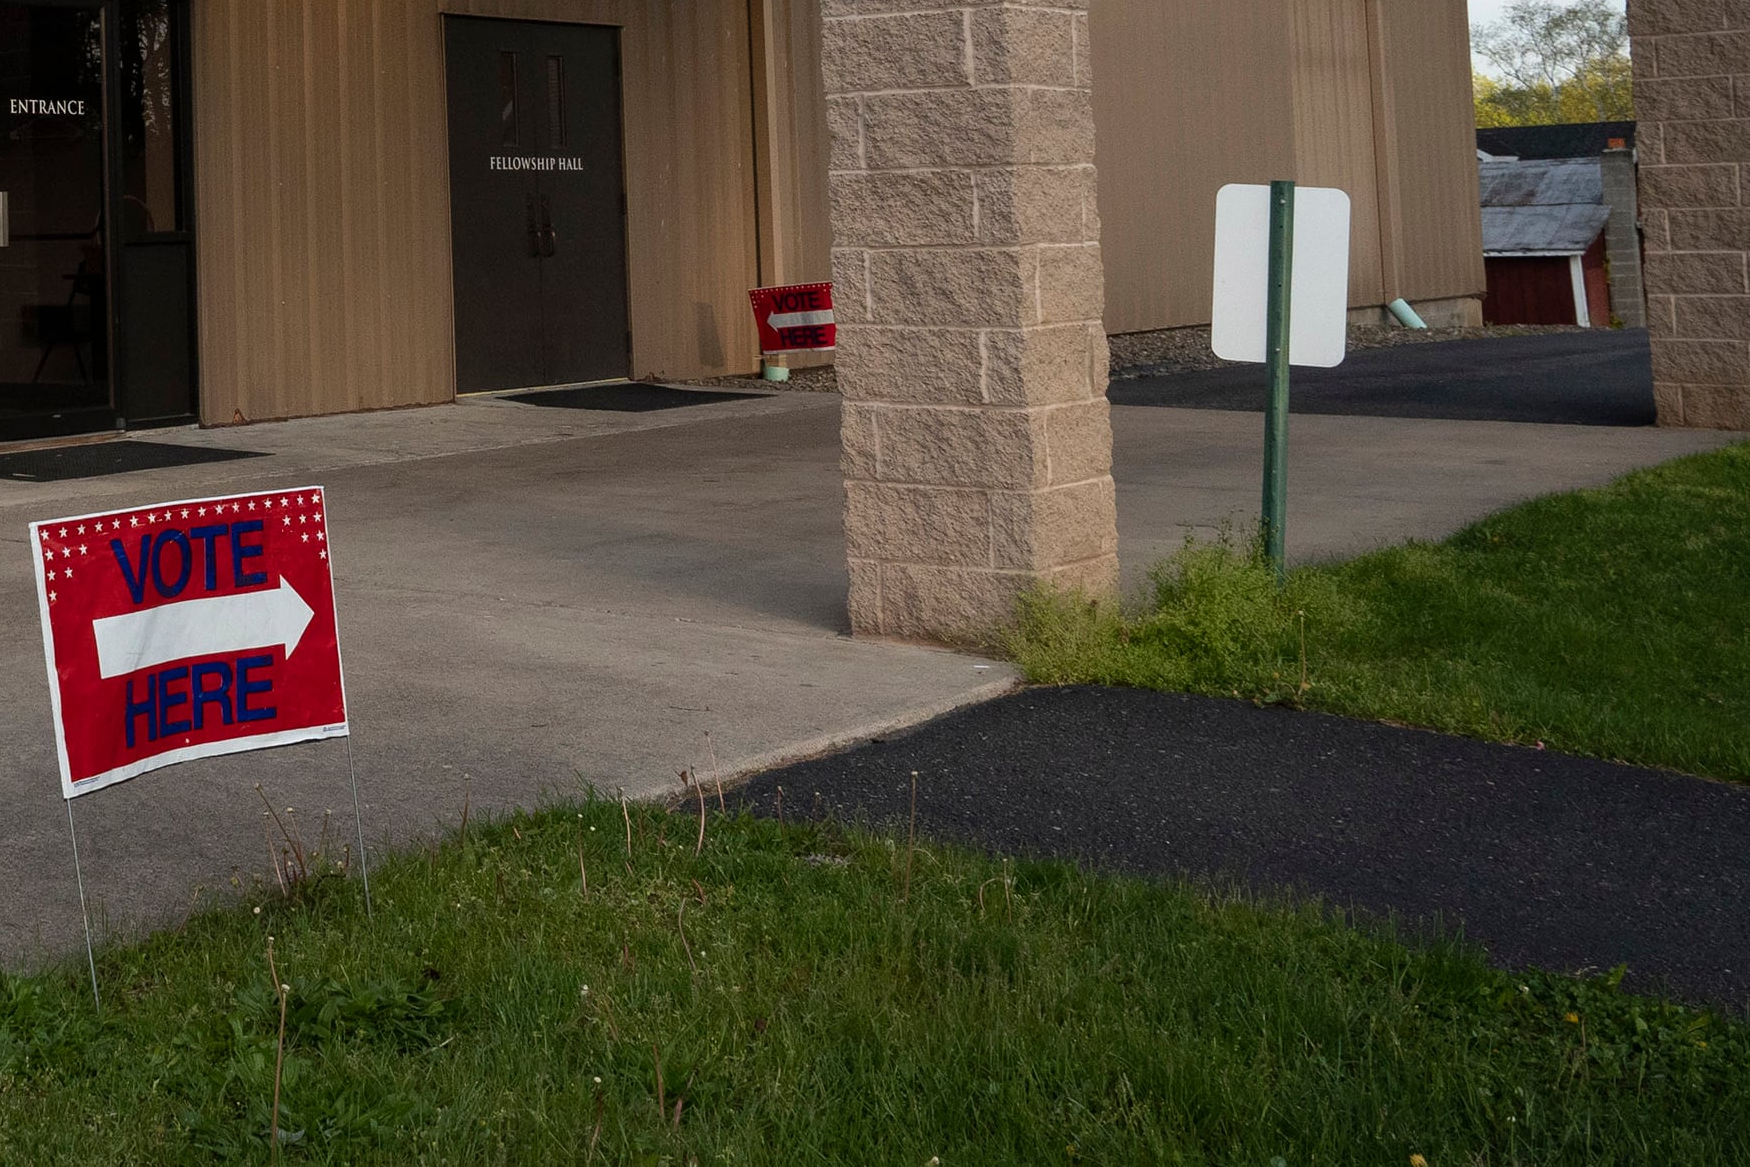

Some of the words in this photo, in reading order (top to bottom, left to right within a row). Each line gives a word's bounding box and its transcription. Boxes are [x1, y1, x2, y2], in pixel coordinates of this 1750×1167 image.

[10, 99, 86, 115] ENTRANCE
[490, 156, 555, 171] FELLOWSHIP
[558, 157, 584, 171] HALL
[772, 291, 821, 311] VOTE
[780, 326, 828, 347] HERE
[110, 520, 267, 604] VOTE
[125, 654, 277, 749] HERE
